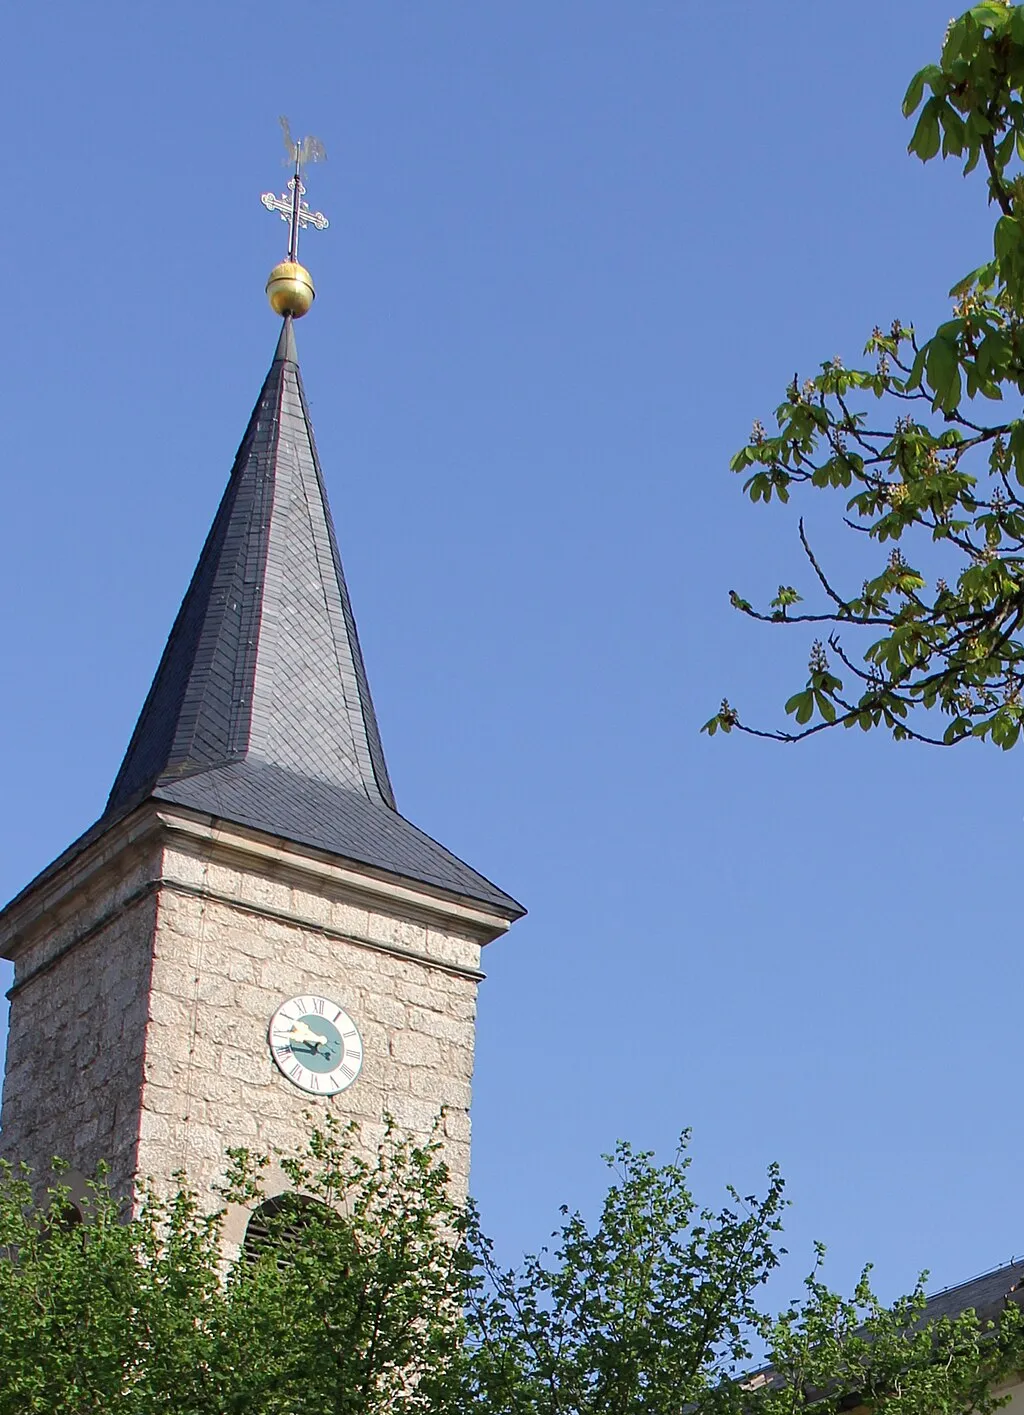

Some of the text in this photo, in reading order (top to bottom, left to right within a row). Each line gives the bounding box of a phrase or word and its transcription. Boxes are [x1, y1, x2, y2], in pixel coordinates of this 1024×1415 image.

[293, 998, 307, 1015] XI
[312, 998, 325, 1015] XII
[333, 1010, 342, 1022] I
[343, 1030, 356, 1038] II
[346, 1049, 361, 1059] III
[289, 1063, 302, 1082] VII
[310, 1074, 320, 1090] VI
[330, 1075, 340, 1090] V
